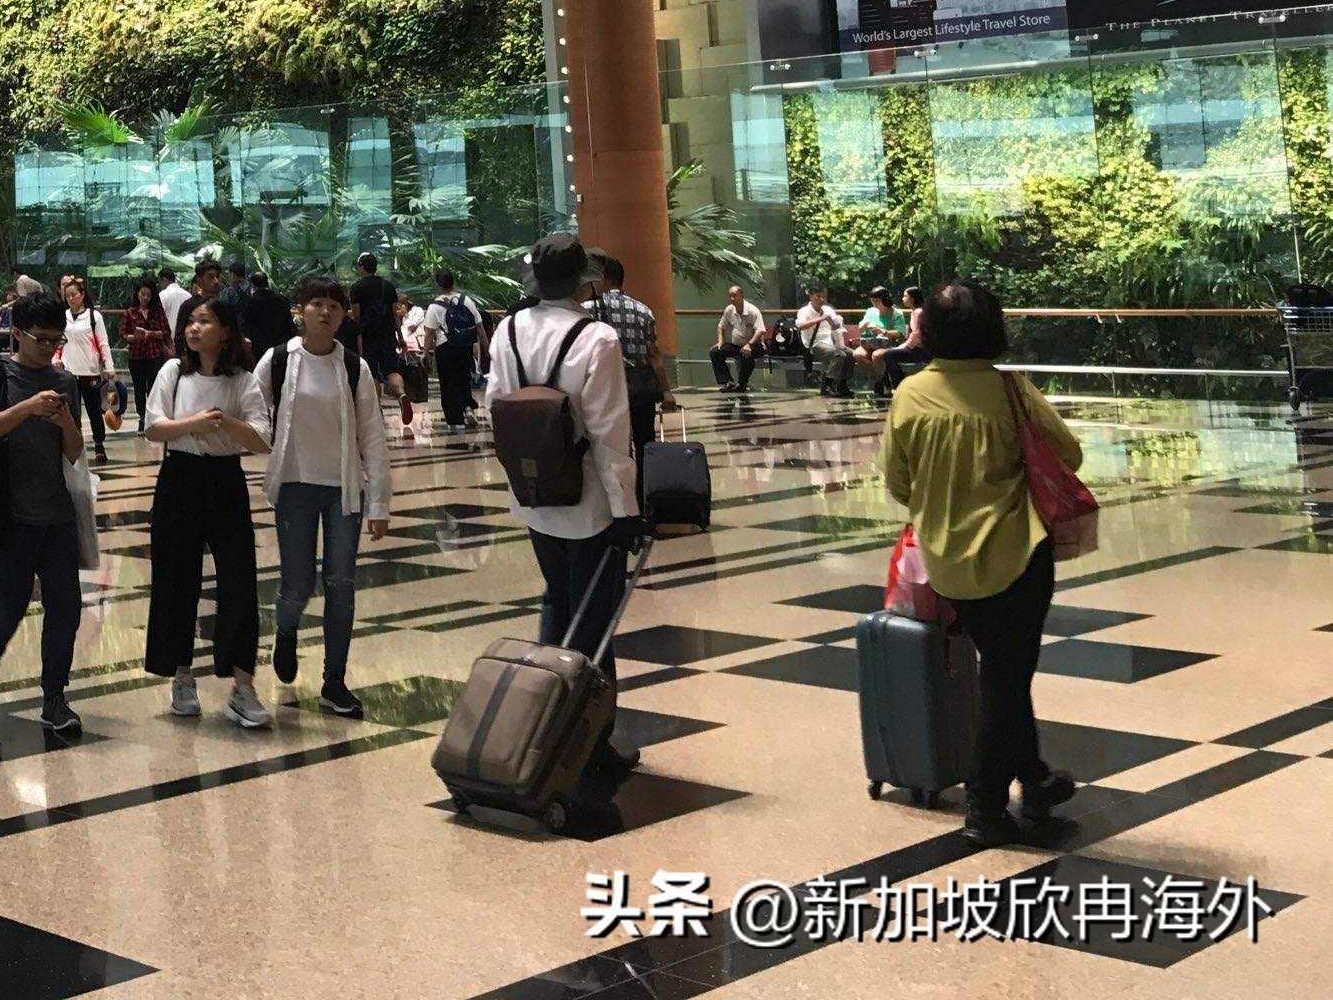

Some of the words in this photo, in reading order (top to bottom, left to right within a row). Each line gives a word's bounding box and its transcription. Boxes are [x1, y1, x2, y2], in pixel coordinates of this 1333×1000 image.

[852, 30, 892, 44] World's
[893, 26, 933, 42] Largest
[934, 19, 982, 37] Lifestyle
[982, 16, 1017, 31] Travel
[1019, 13, 1051, 28] Store
